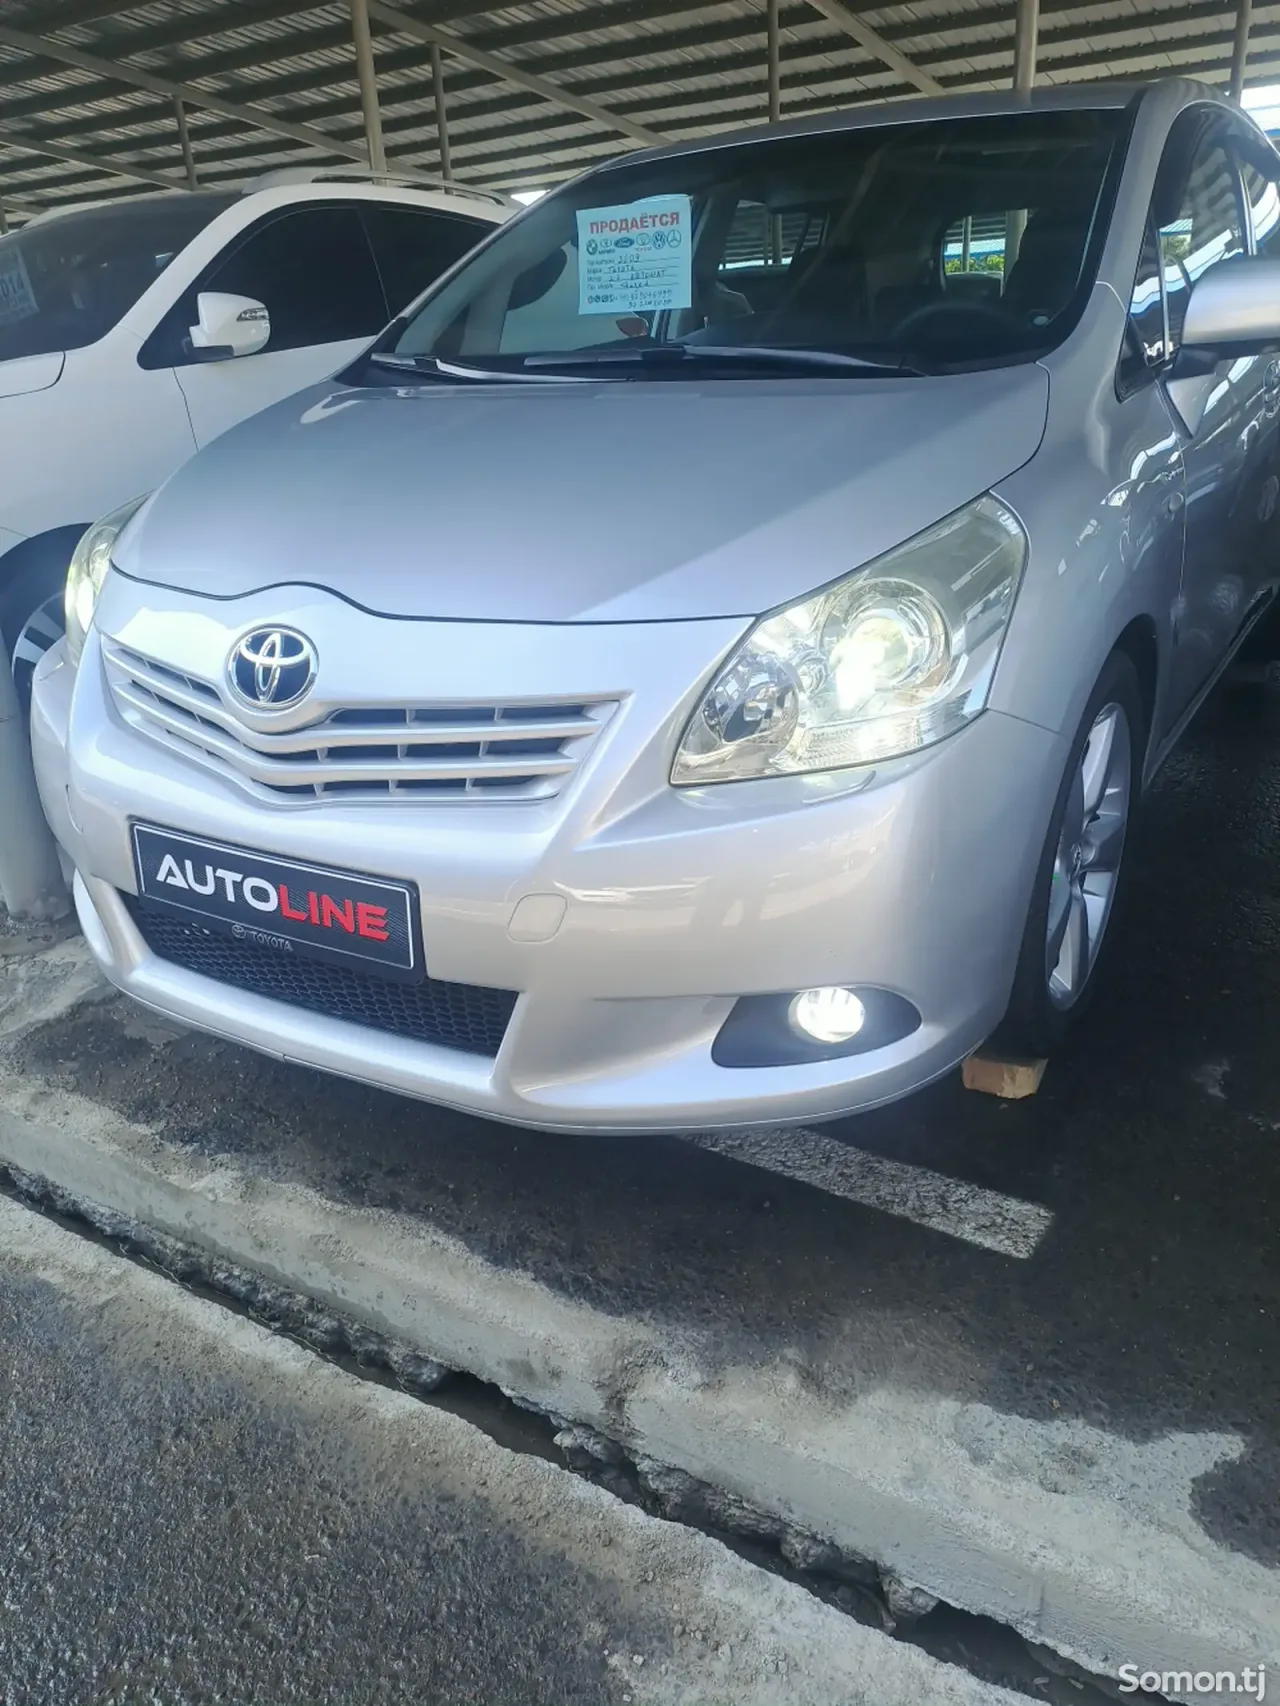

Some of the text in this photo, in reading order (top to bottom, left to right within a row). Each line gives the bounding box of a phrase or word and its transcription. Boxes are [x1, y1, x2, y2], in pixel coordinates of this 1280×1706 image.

[589, 211, 680, 235] ПРОДАЁТСЯ
[155, 853, 390, 942] AUTOLINE
[248, 930, 294, 952] TOYOTA
